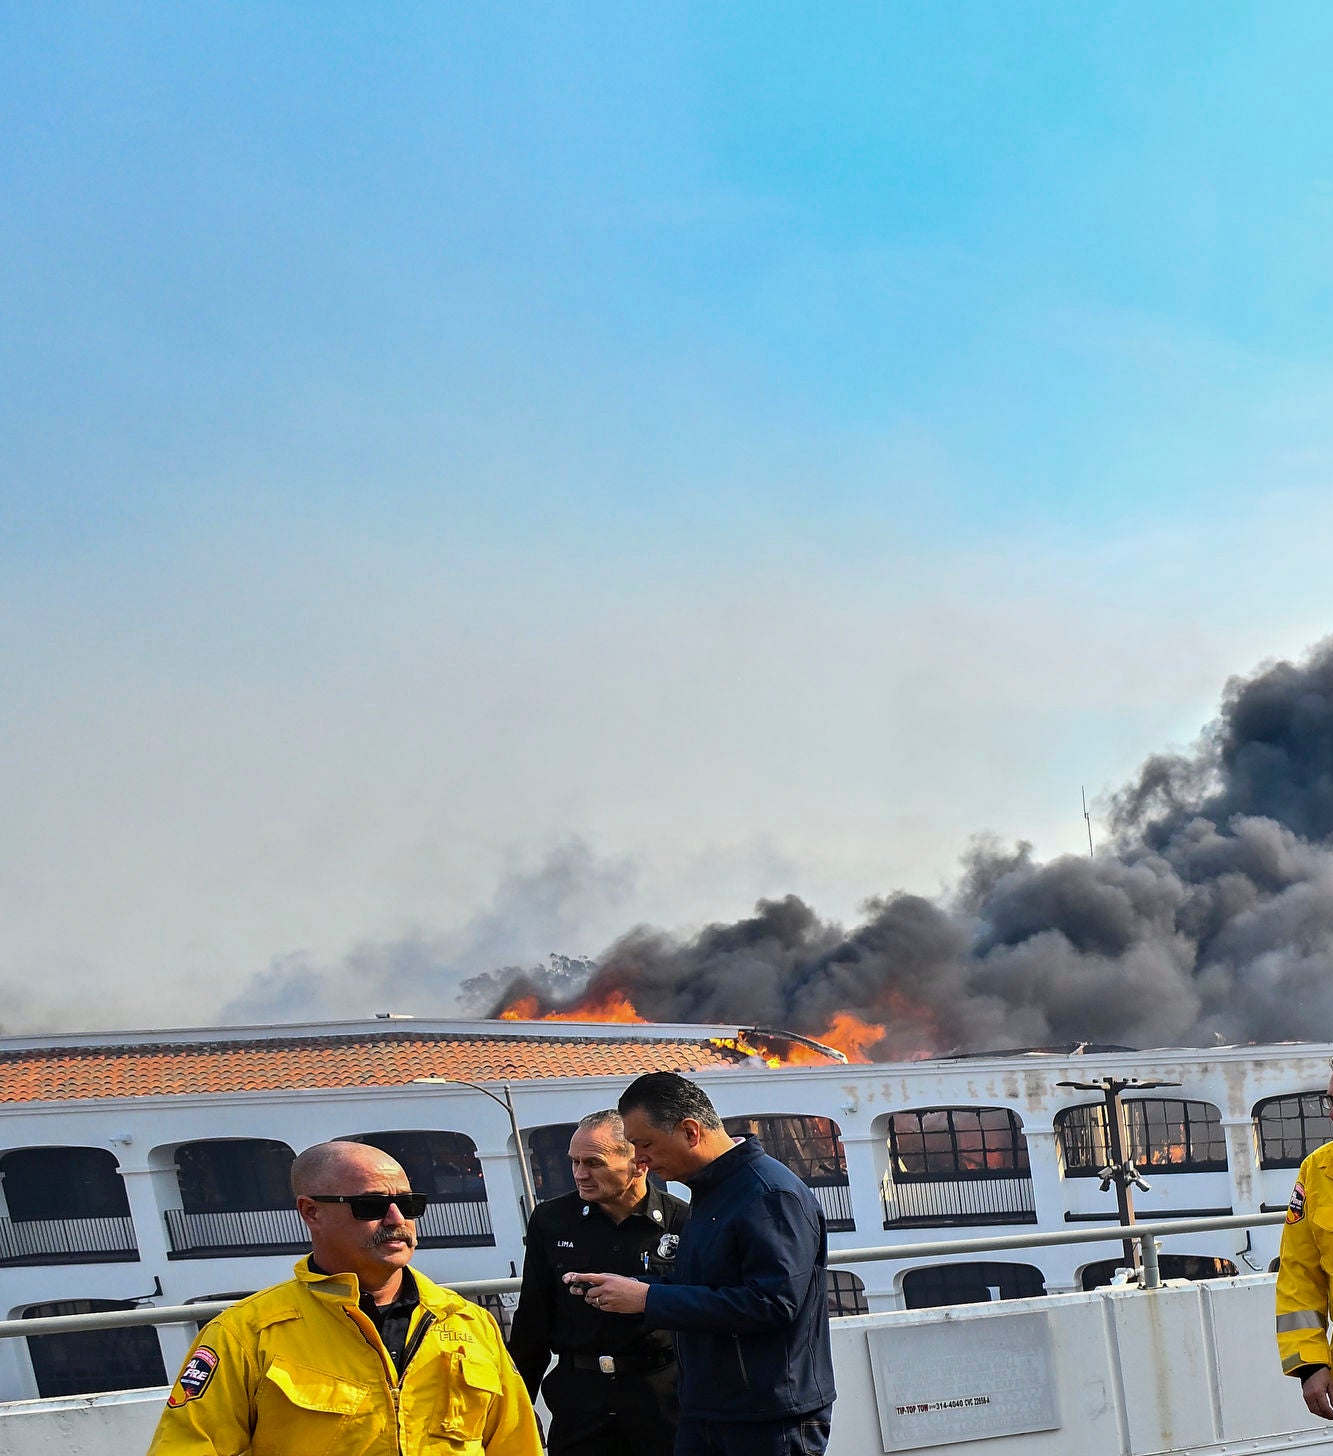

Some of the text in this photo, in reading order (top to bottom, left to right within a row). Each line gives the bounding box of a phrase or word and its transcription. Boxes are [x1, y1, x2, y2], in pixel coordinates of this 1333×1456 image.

[557, 1240, 574, 1249] LIMA
[440, 1332, 474, 1344] FIRE
[896, 1406, 917, 1416] TIP-TOP
[917, 1404, 929, 1412] TOW
